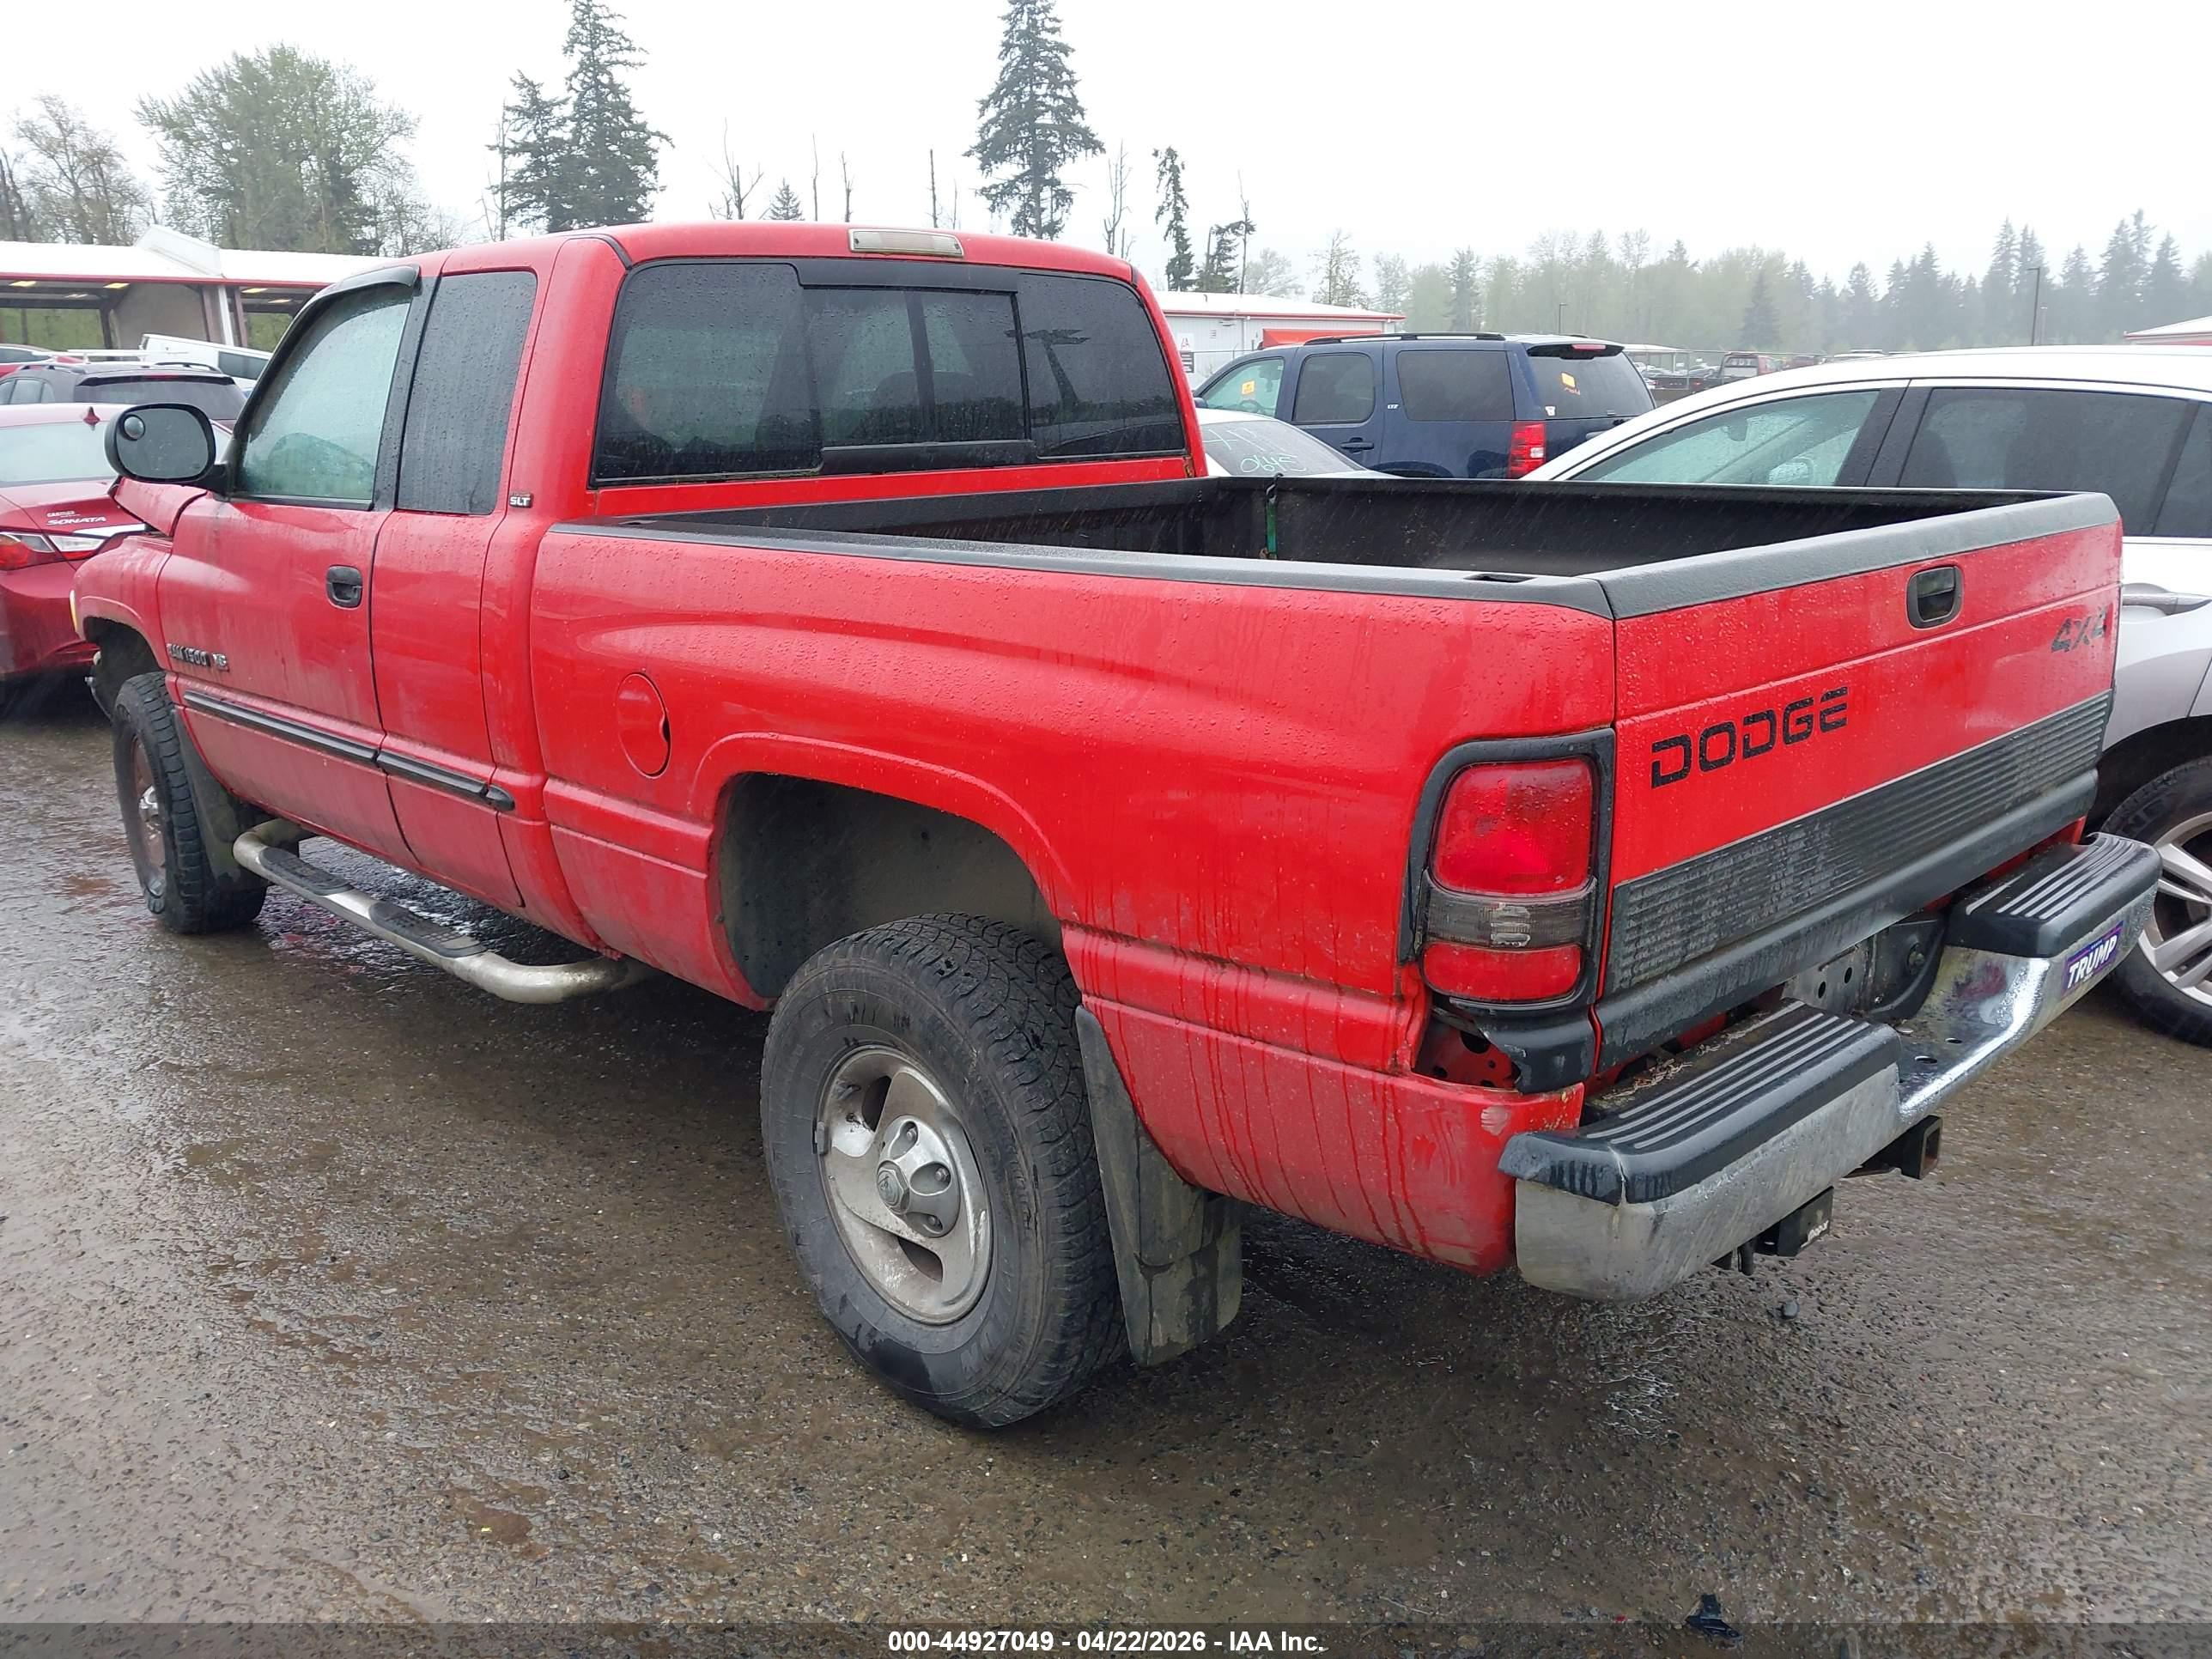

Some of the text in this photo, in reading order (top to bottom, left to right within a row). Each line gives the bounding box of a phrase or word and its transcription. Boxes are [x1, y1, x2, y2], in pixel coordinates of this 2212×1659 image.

[510, 496, 531, 507] SLT
[46, 516, 106, 526] SONATA
[1651, 686, 1849, 789] DODGE
[2067, 934, 2118, 989] TRUMP
